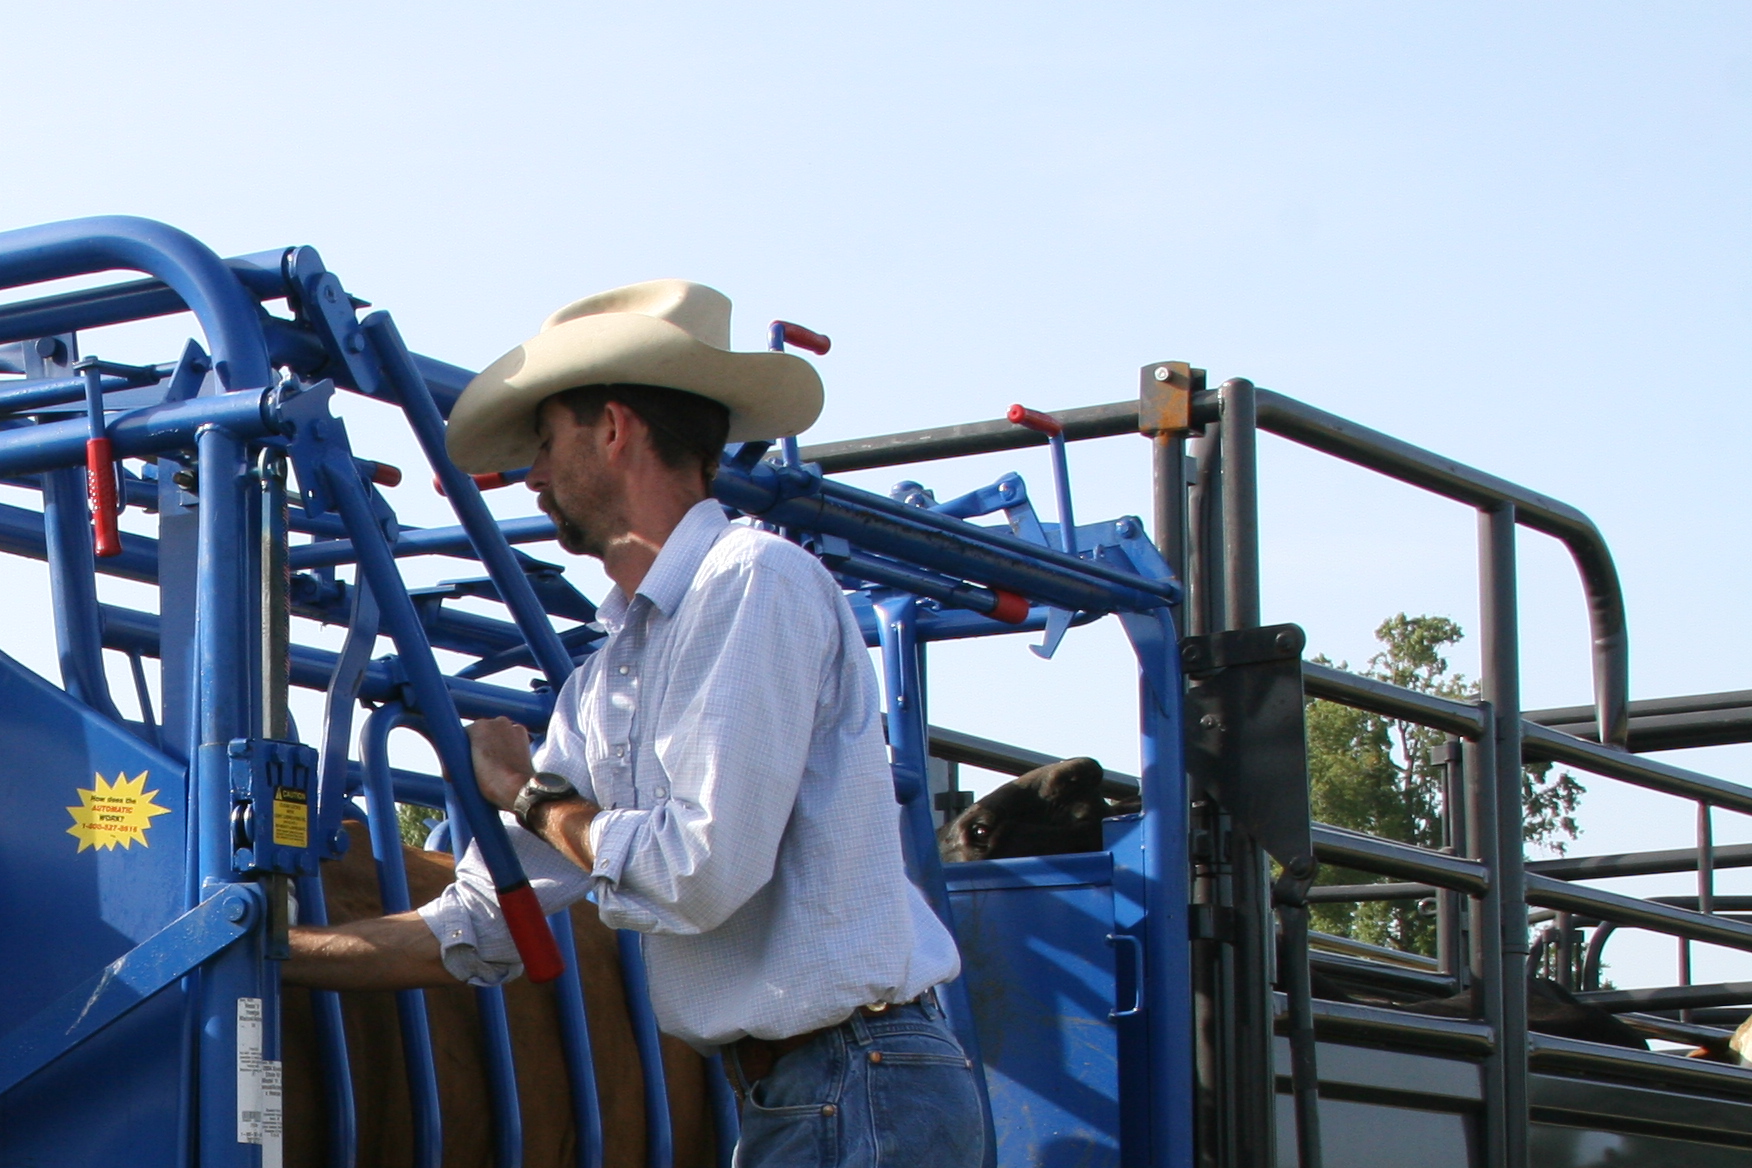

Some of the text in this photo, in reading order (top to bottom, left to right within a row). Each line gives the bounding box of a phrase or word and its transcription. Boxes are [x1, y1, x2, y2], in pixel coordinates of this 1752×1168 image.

[282, 790, 306, 800] CAUTION
[91, 804, 133, 814] AUTOMATIC
[99, 814, 125, 822] WORK?
